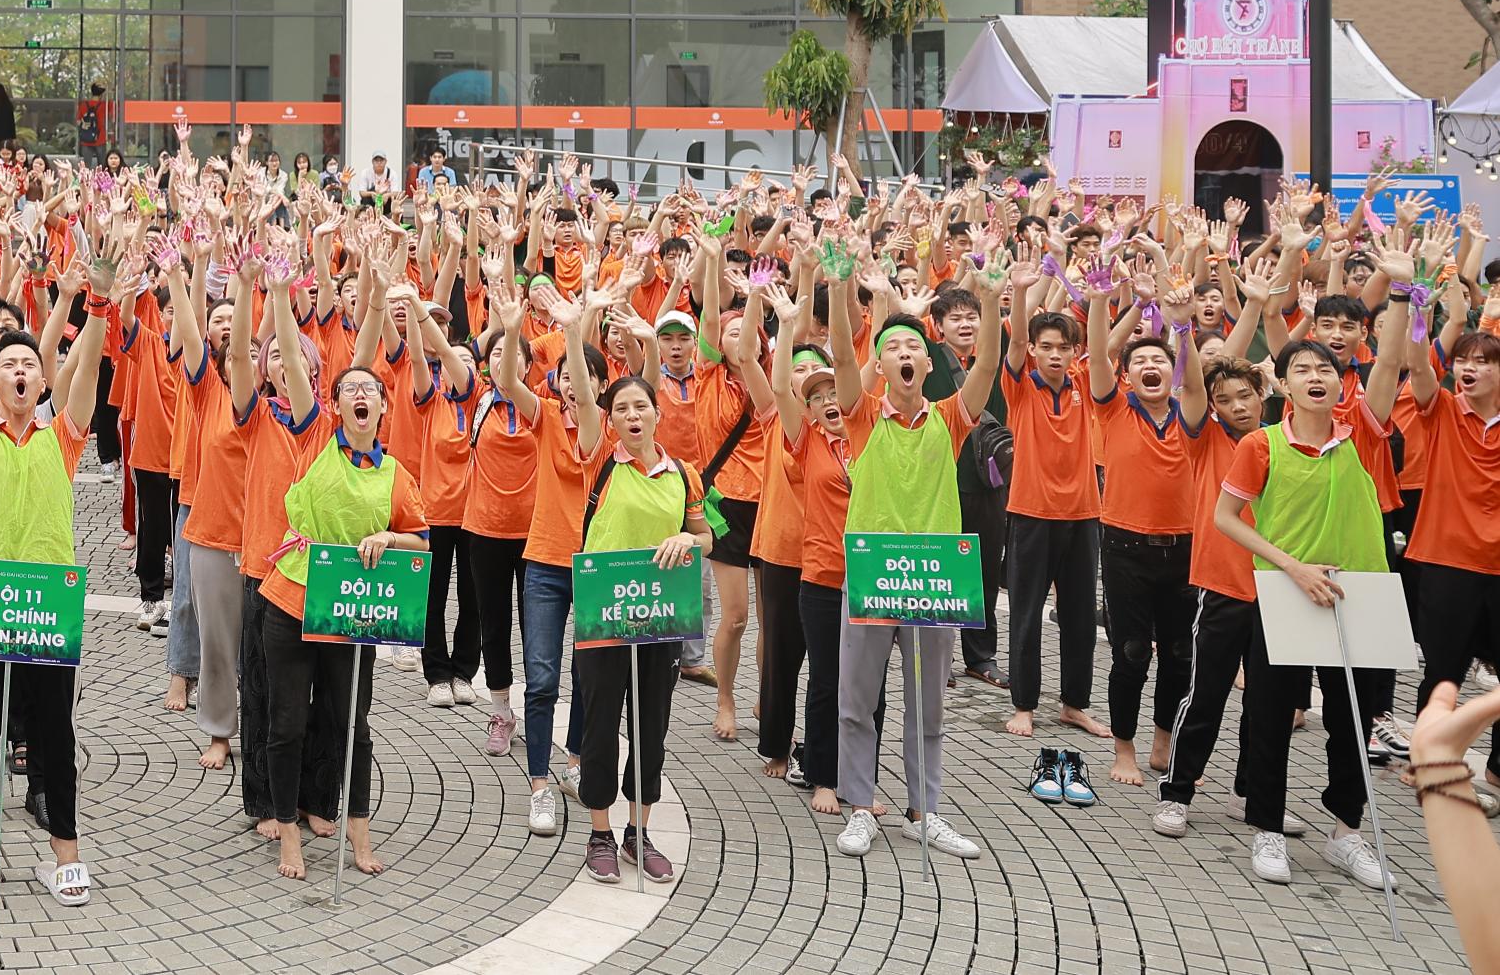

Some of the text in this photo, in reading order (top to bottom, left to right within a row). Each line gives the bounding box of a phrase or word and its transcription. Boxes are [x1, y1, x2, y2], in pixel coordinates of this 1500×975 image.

[885, 555, 941, 574] ĐỘI 10
[340, 577, 395, 600] ĐỘI 16
[613, 579, 662, 602] ĐỘI 5
[876, 572, 952, 595] QUẢN TRỊ
[25, 589, 42, 604] 11
[863, 596, 968, 612] KINH DOANH
[2, 607, 57, 626] CHÍNH
[333, 602, 399, 623] DU LỊCH
[602, 599, 675, 622] KẾ TOÁN
[15, 628, 66, 648] HÀNG
[56, 868, 81, 886] RDY
